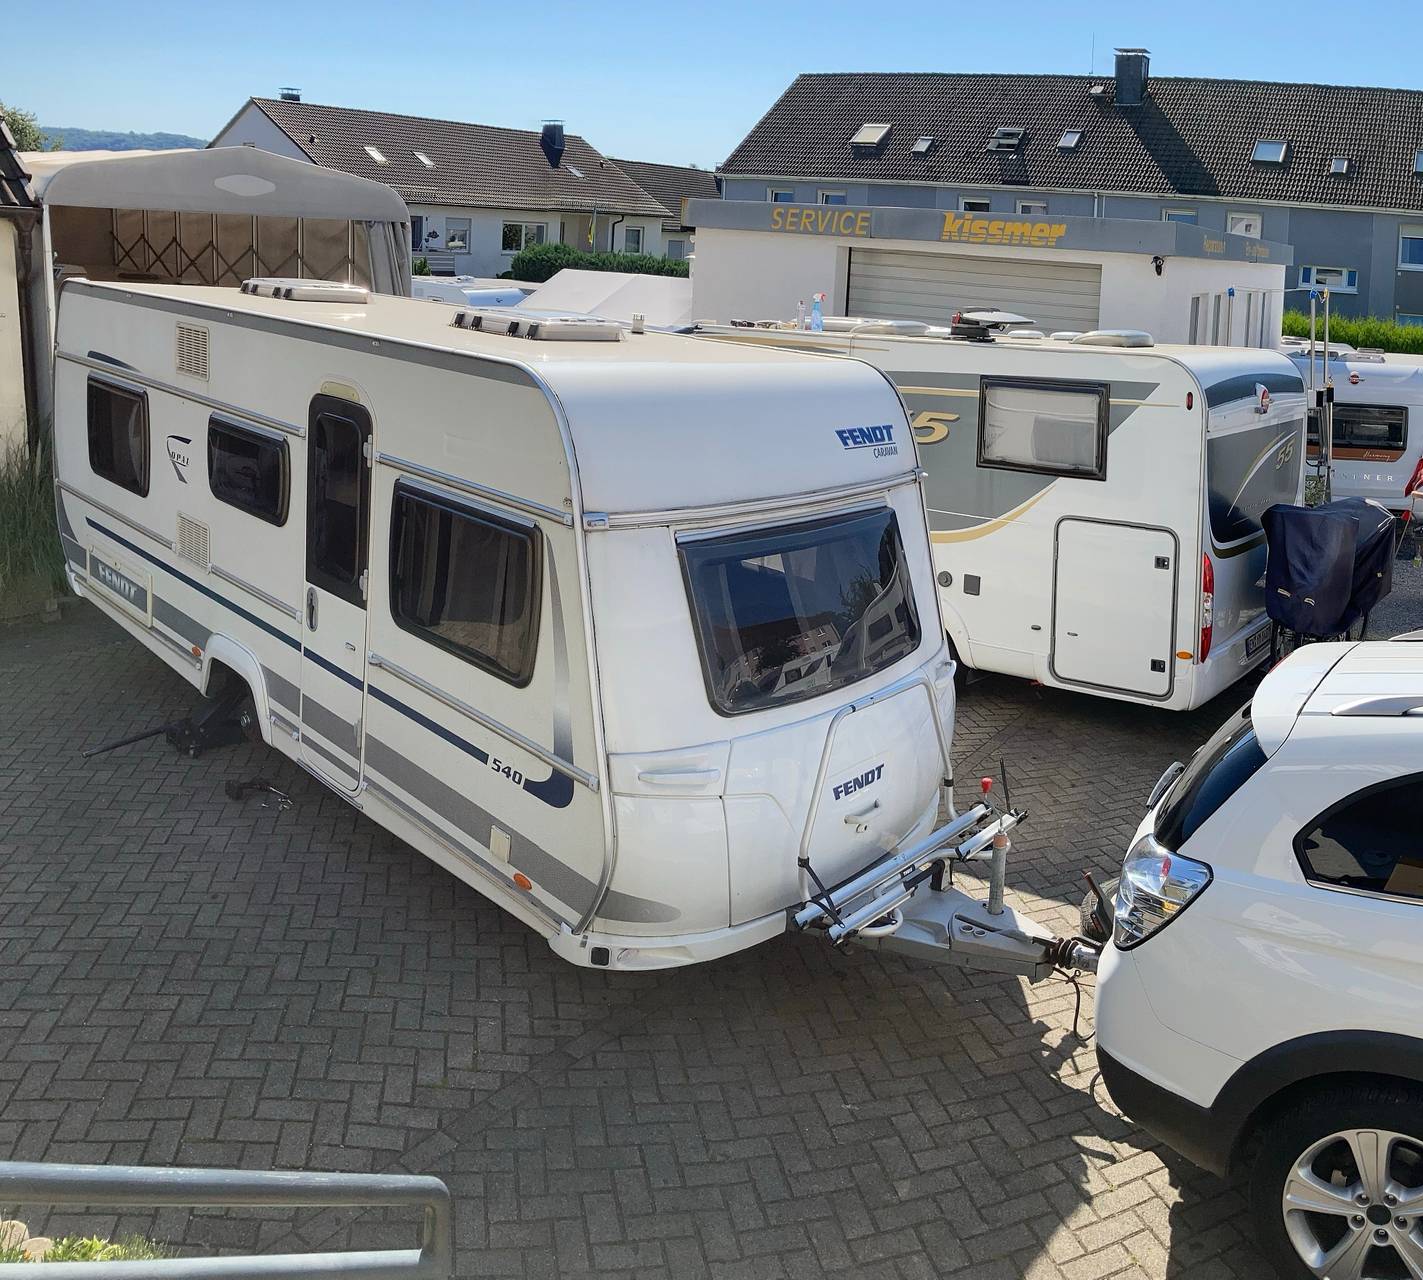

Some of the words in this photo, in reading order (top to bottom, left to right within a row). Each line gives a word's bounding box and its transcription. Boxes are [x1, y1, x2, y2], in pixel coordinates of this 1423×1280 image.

[771, 207, 871, 235] SERVICE
[941, 211, 1066, 246] kissmer
[835, 424, 893, 447] FENDT
[909, 411, 960, 445] 5
[873, 446, 898, 459] CARAVAN
[1275, 438, 1296, 470] 55
[98, 561, 137, 599] FENDT
[491, 758, 523, 785] 540
[832, 763, 885, 801] FENDT
